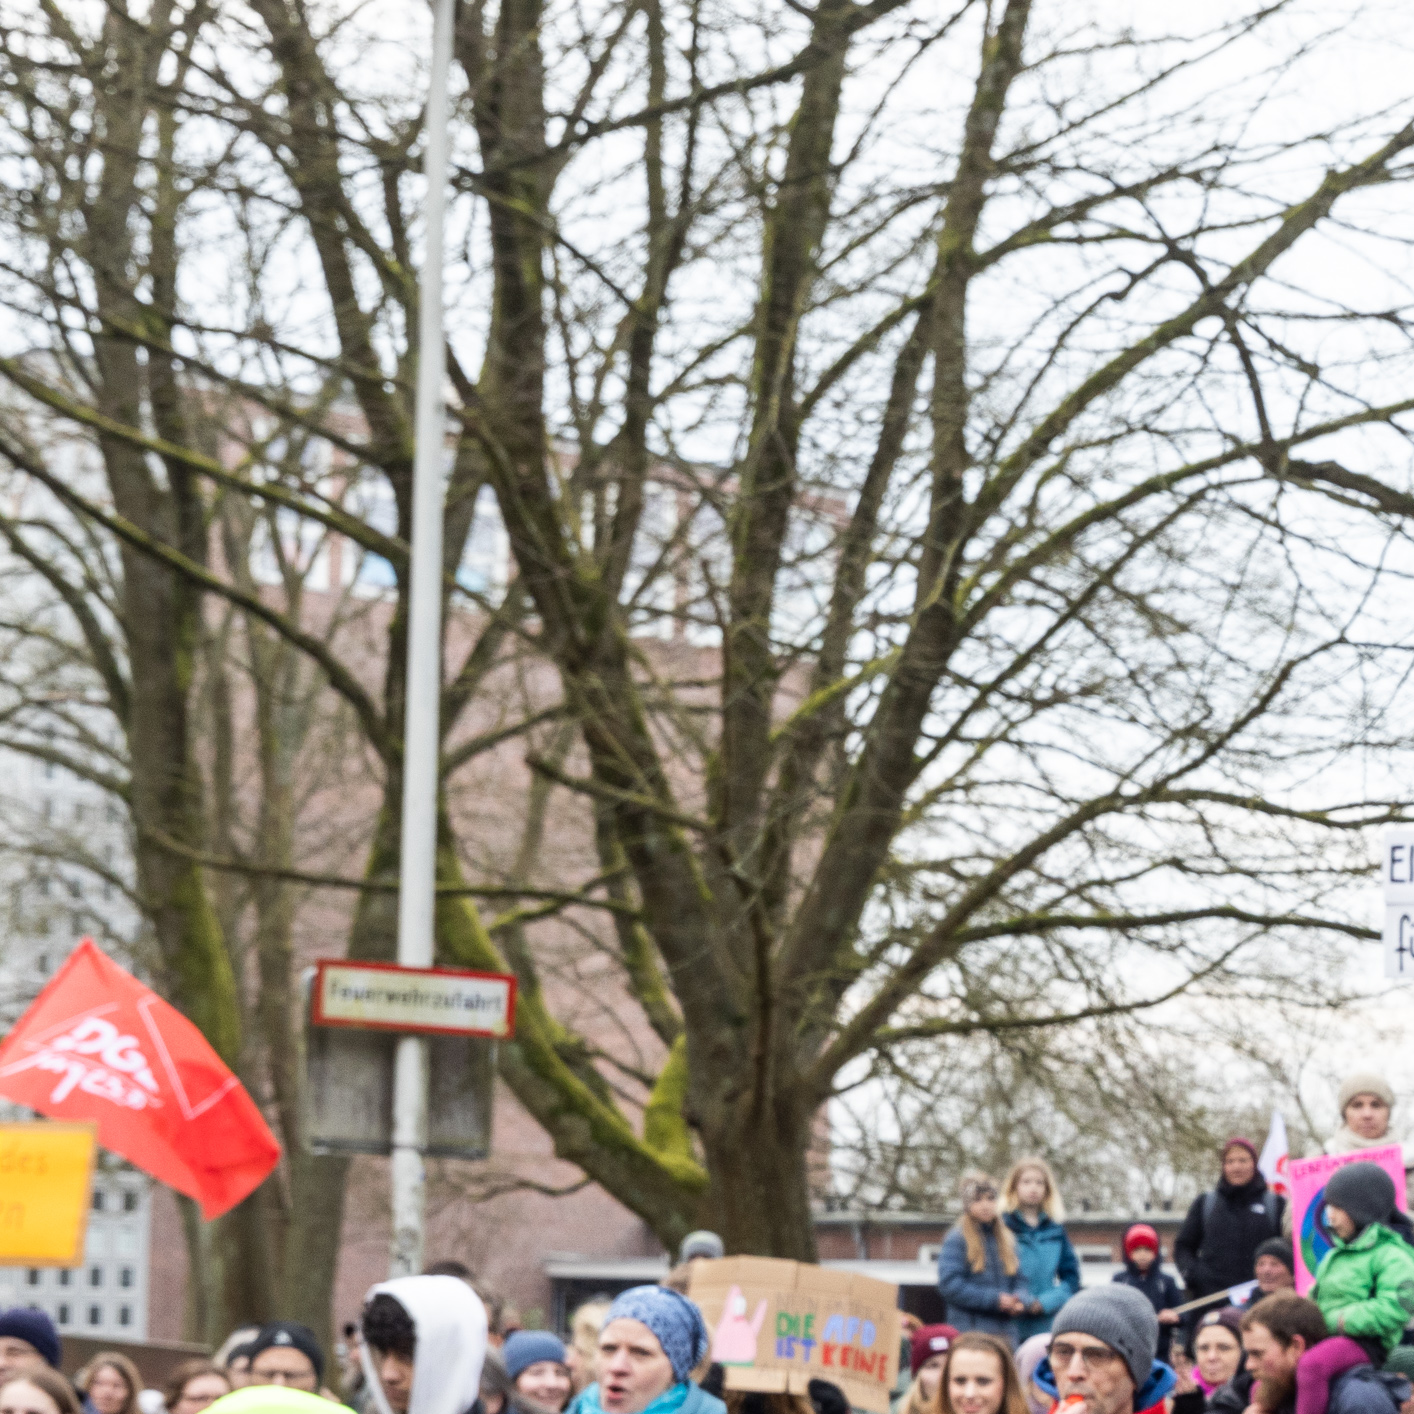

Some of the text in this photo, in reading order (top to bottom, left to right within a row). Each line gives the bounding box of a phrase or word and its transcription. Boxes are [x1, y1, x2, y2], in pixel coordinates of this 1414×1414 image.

[775, 1311, 877, 1349] DIE AFD
[775, 1335, 889, 1383] IST KEINE
